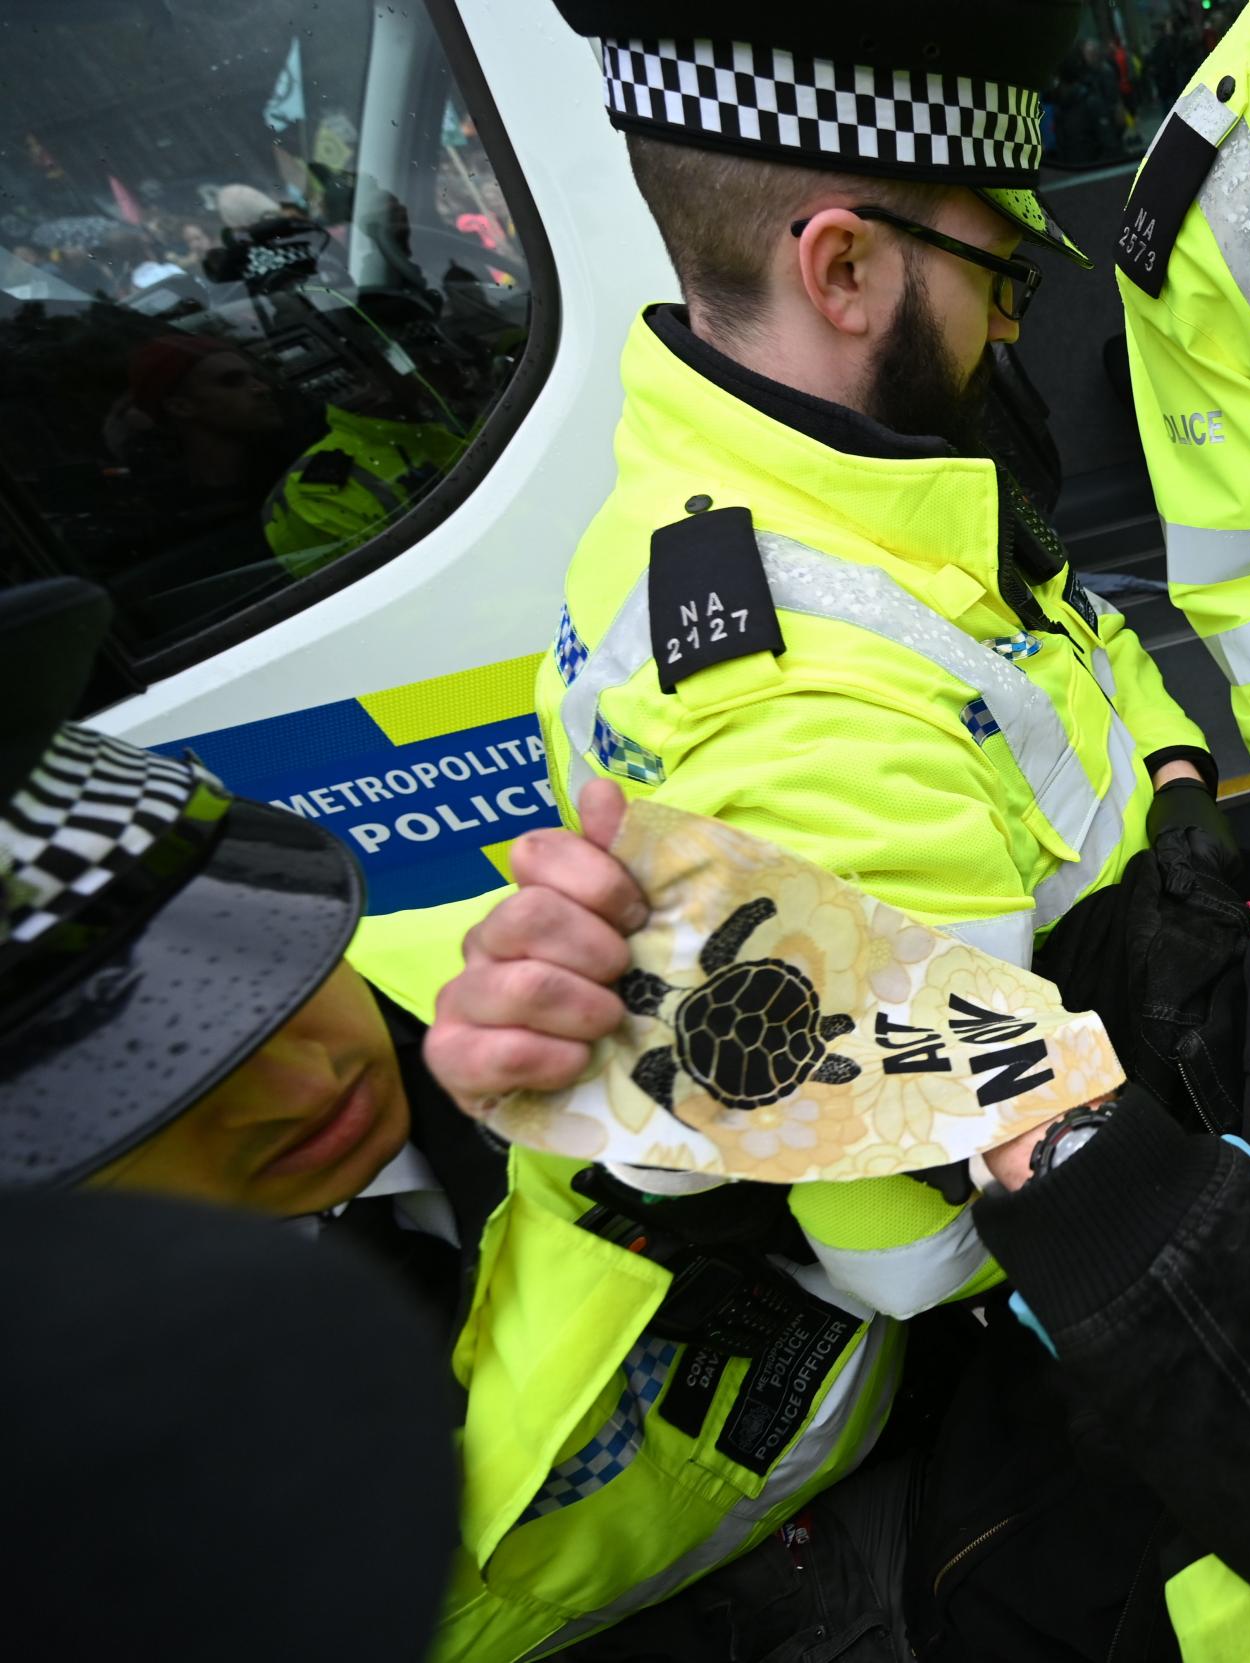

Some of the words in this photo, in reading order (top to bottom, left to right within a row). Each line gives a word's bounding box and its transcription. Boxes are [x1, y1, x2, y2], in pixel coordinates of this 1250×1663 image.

[1119, 227, 1156, 272] 2573
[1135, 208, 1156, 241] NA
[667, 609, 748, 664] 2127
[268, 735, 546, 818] METROPOLITA
[875, 1012, 952, 1075] ACT
[948, 993, 1055, 1107] NOW
[770, 1329, 810, 1388] POLICE
[755, 1393, 803, 1460] POLICE
[793, 1320, 848, 1393] OFFICER
